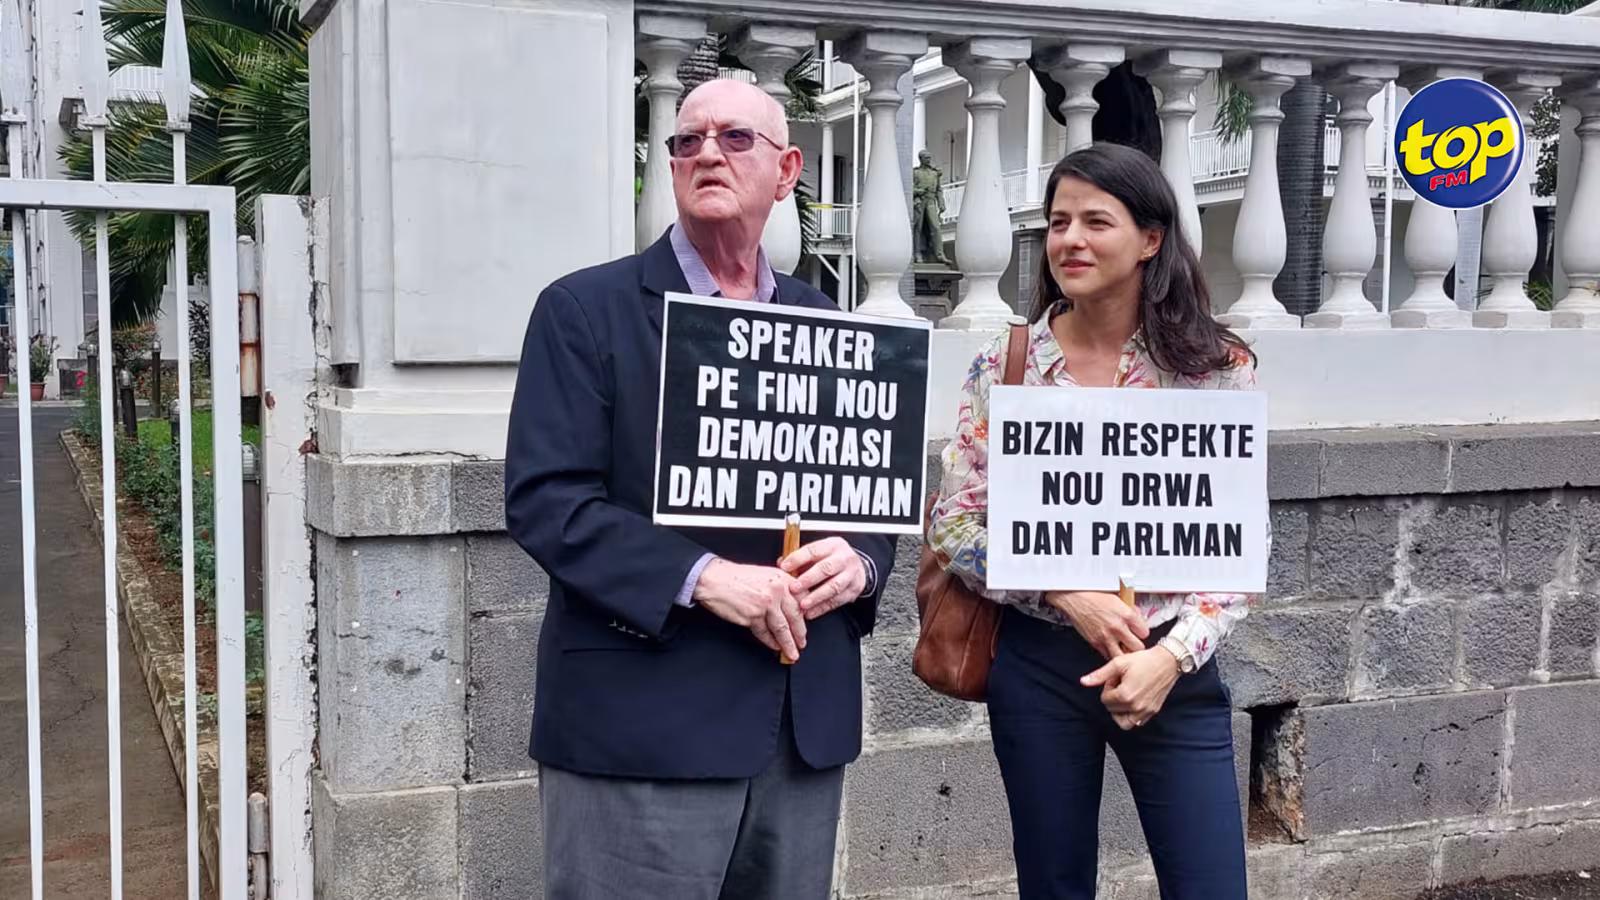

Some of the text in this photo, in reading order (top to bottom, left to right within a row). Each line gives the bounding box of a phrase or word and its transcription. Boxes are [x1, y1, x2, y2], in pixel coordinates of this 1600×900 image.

[727, 317, 875, 371] SPEAKER
[696, 365, 898, 421] PE FINI NOU
[697, 416, 892, 469] DEMOKRASI
[1002, 420, 1253, 458] BIZIN RESPEKTE
[667, 464, 913, 517] DAN PARLMAN
[1041, 471, 1213, 507] NOU DRWA
[1011, 520, 1242, 557] DAN PARLMAN
